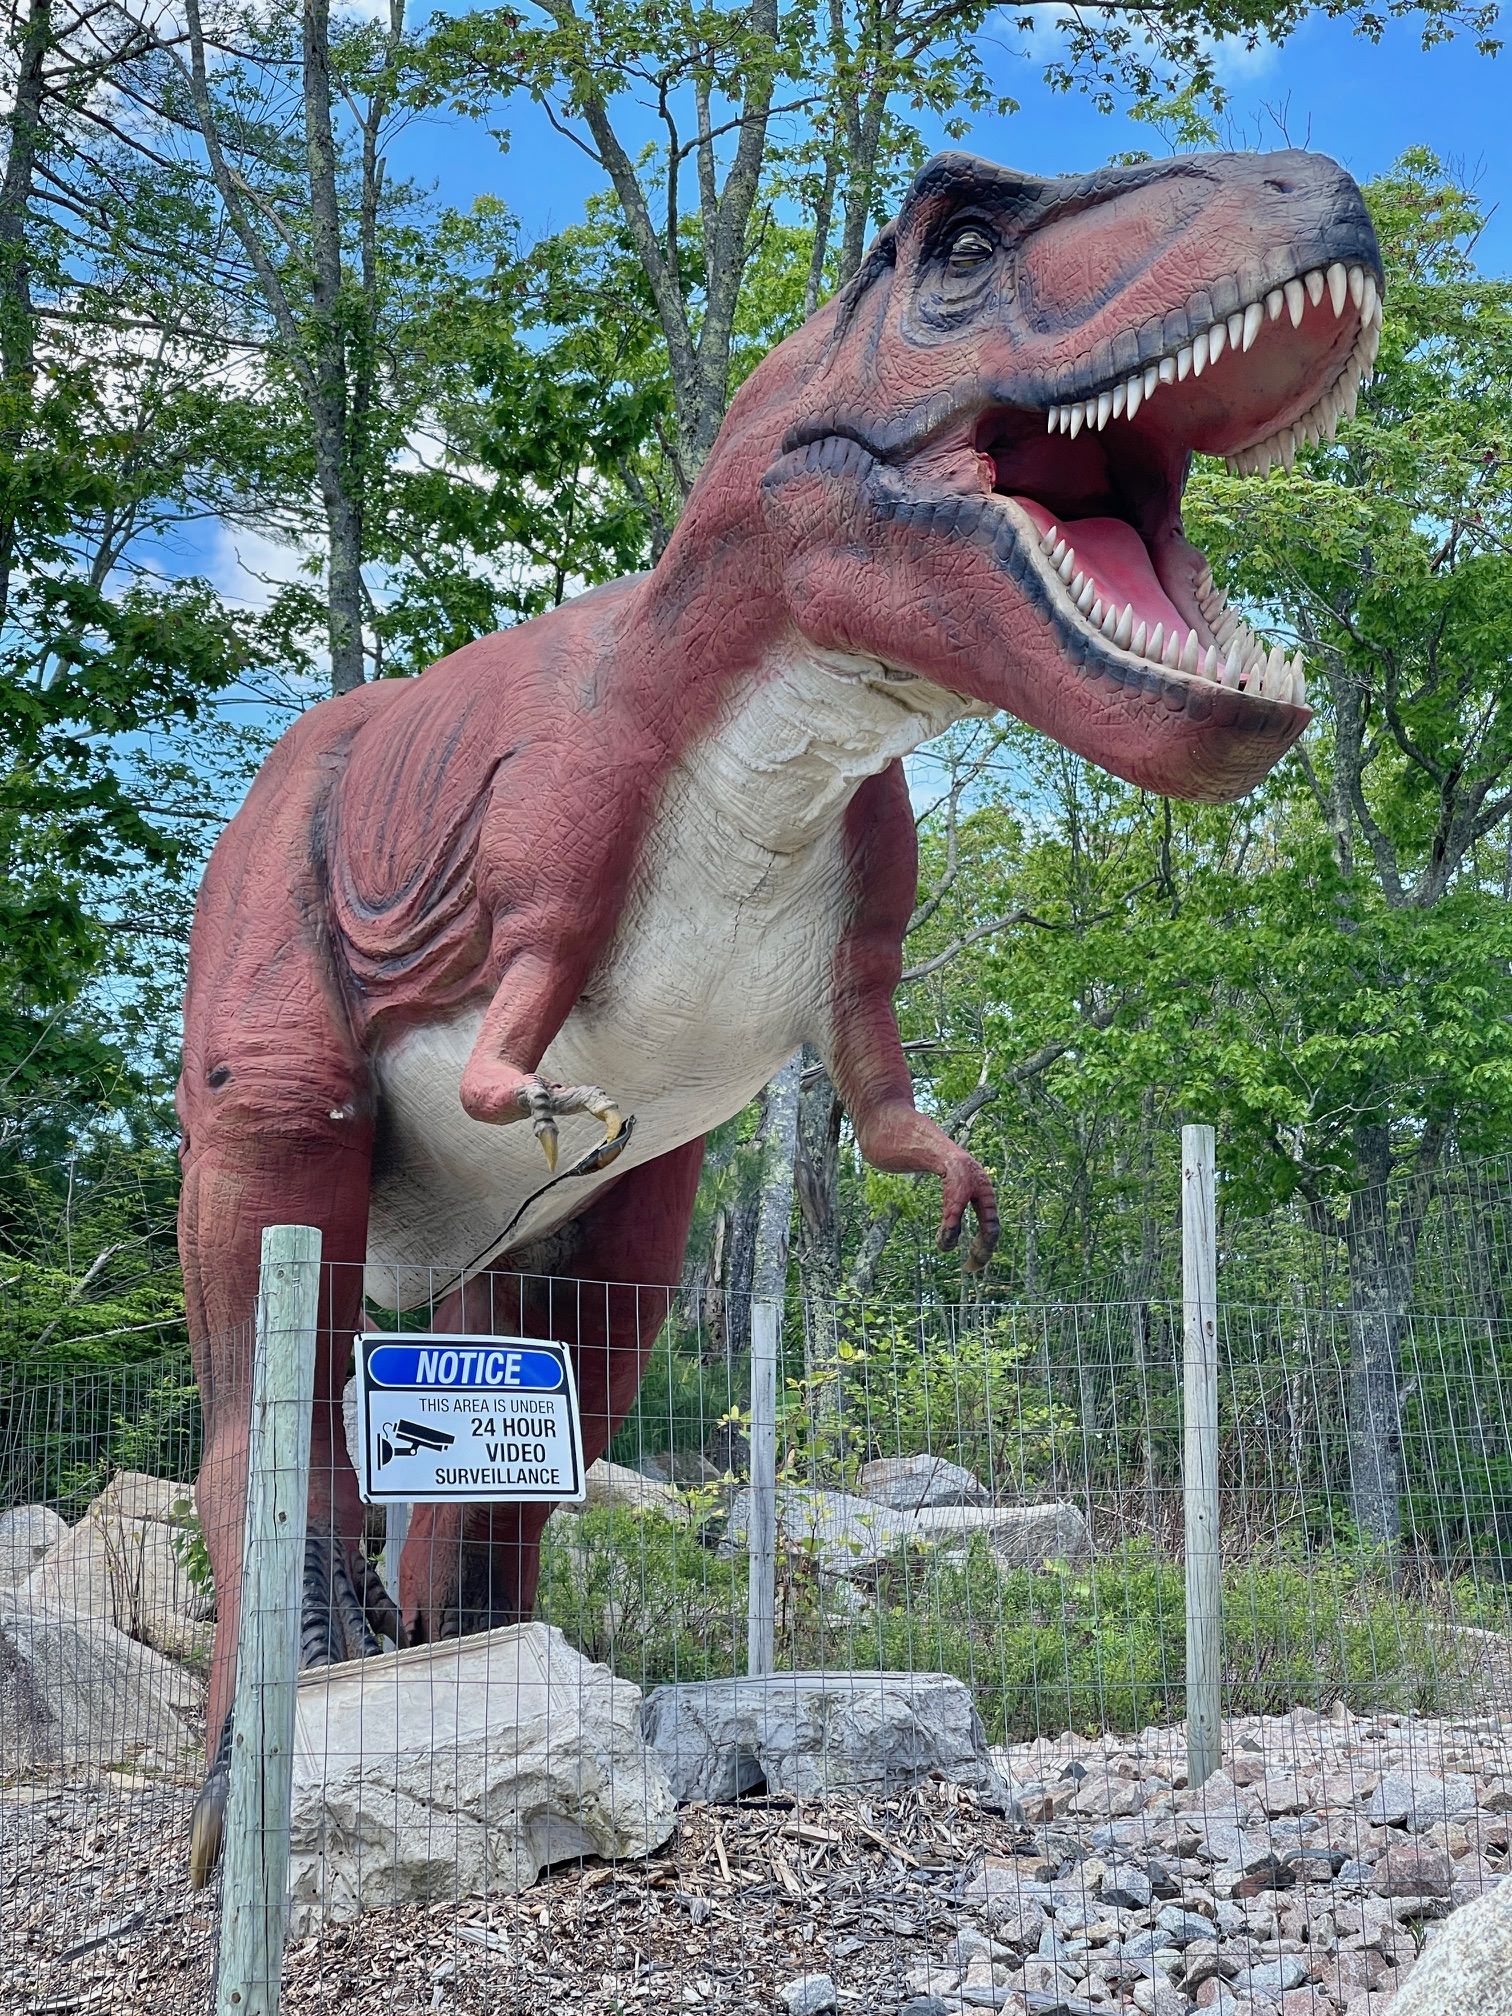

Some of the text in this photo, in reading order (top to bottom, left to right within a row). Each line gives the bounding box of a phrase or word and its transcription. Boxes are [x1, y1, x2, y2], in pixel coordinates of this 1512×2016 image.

[416, 1351, 522, 1385] NOTICE
[419, 1398, 555, 1414] THIS AREA IS UNDER
[471, 1417, 556, 1438] 24 HOUR
[486, 1443, 546, 1463] VIDEO
[435, 1468, 560, 1485] SURVEILLANCE
